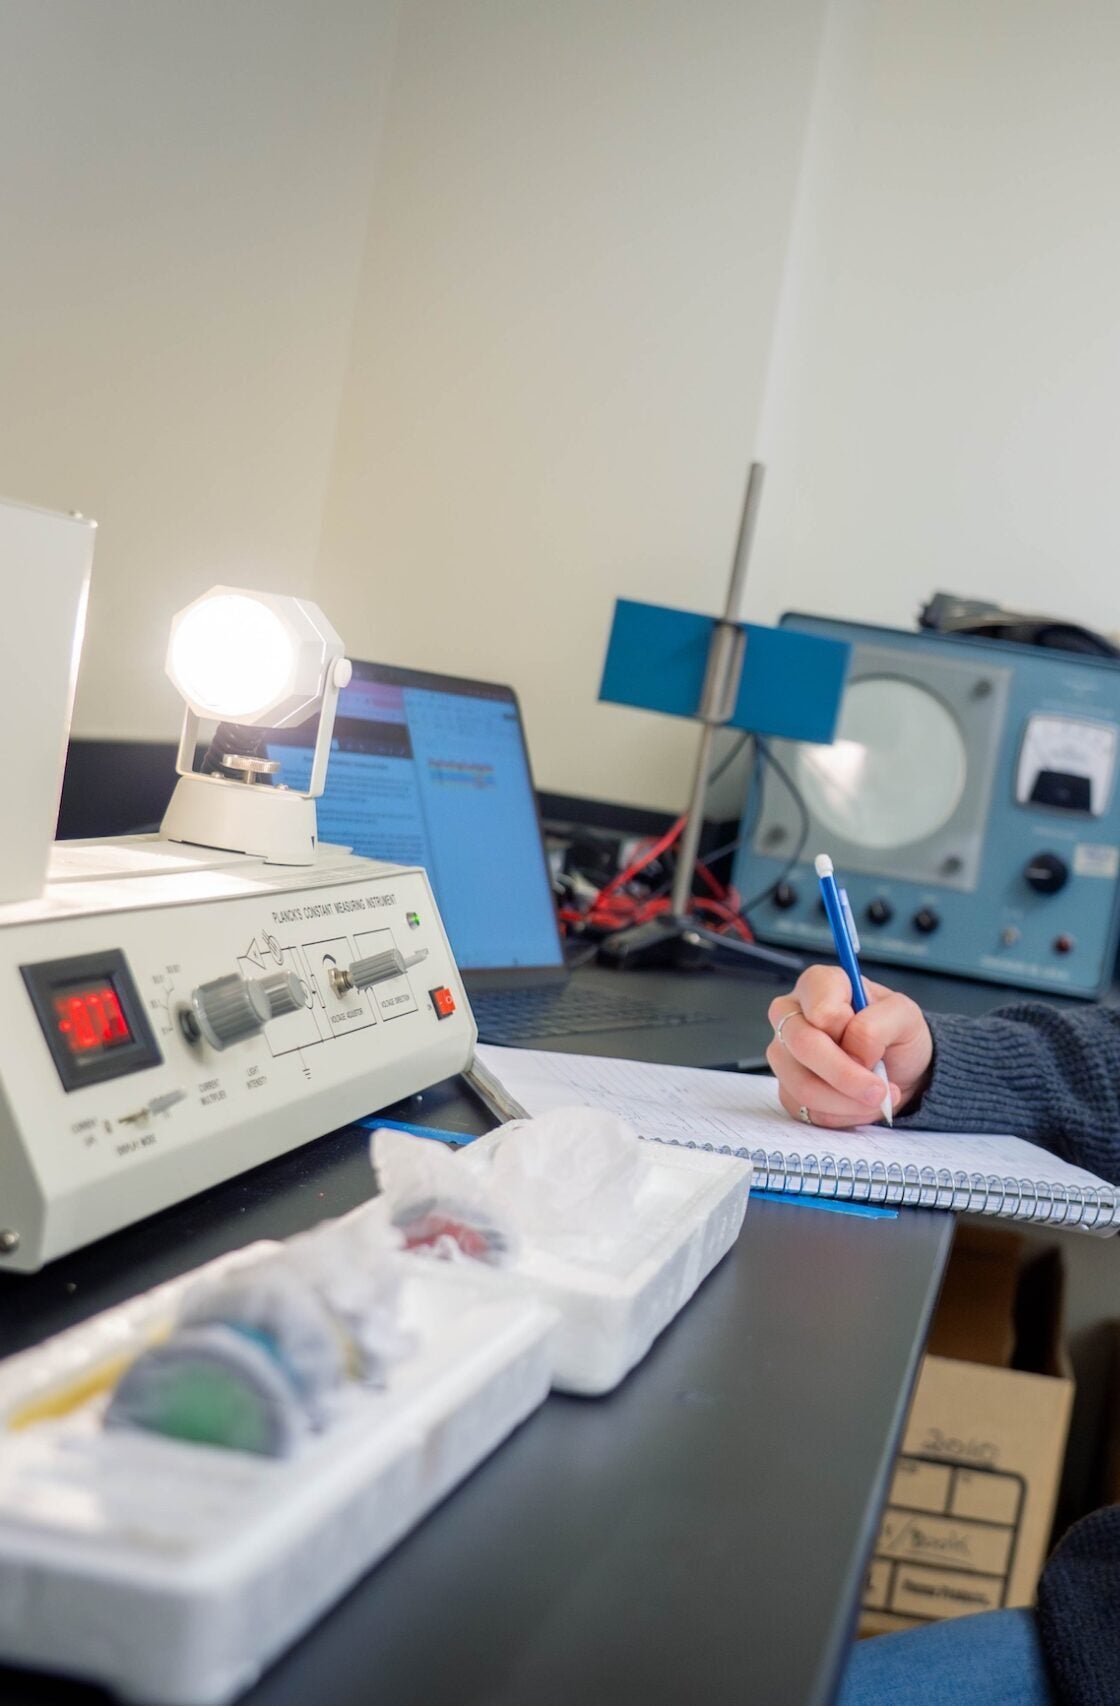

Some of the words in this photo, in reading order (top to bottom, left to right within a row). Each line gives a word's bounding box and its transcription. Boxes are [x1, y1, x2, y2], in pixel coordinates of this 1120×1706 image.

[272, 908, 302, 923] PLANCK'S
[303, 903, 332, 919] CONSTANT
[333, 898, 366, 914] MEASURING
[365, 894, 396, 909] INSTRUMENT
